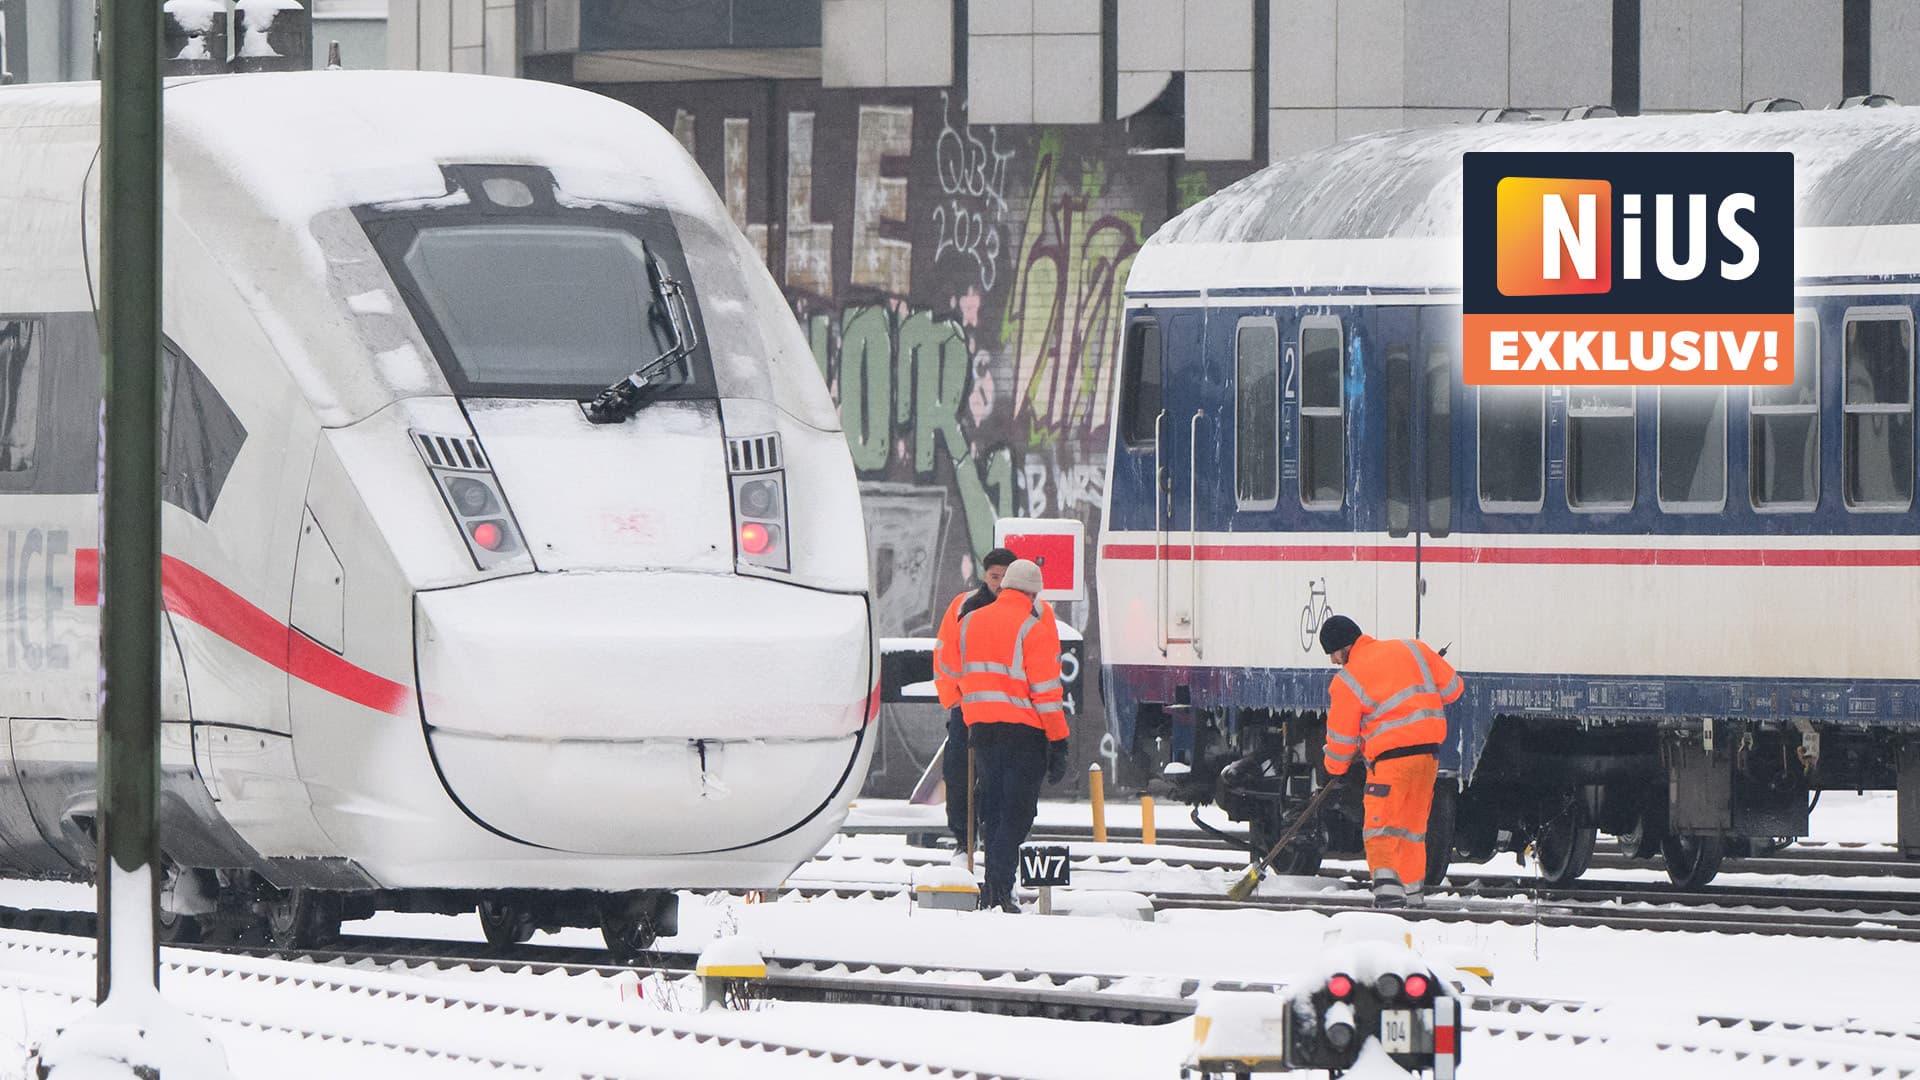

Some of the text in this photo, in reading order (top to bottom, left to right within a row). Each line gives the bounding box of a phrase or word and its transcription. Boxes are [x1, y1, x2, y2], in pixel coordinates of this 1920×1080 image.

[1285, 347, 1295, 398] 2
[6, 528, 69, 670] ICE
[1024, 855, 1066, 879] W7
[1386, 1021, 1406, 1042] 104
